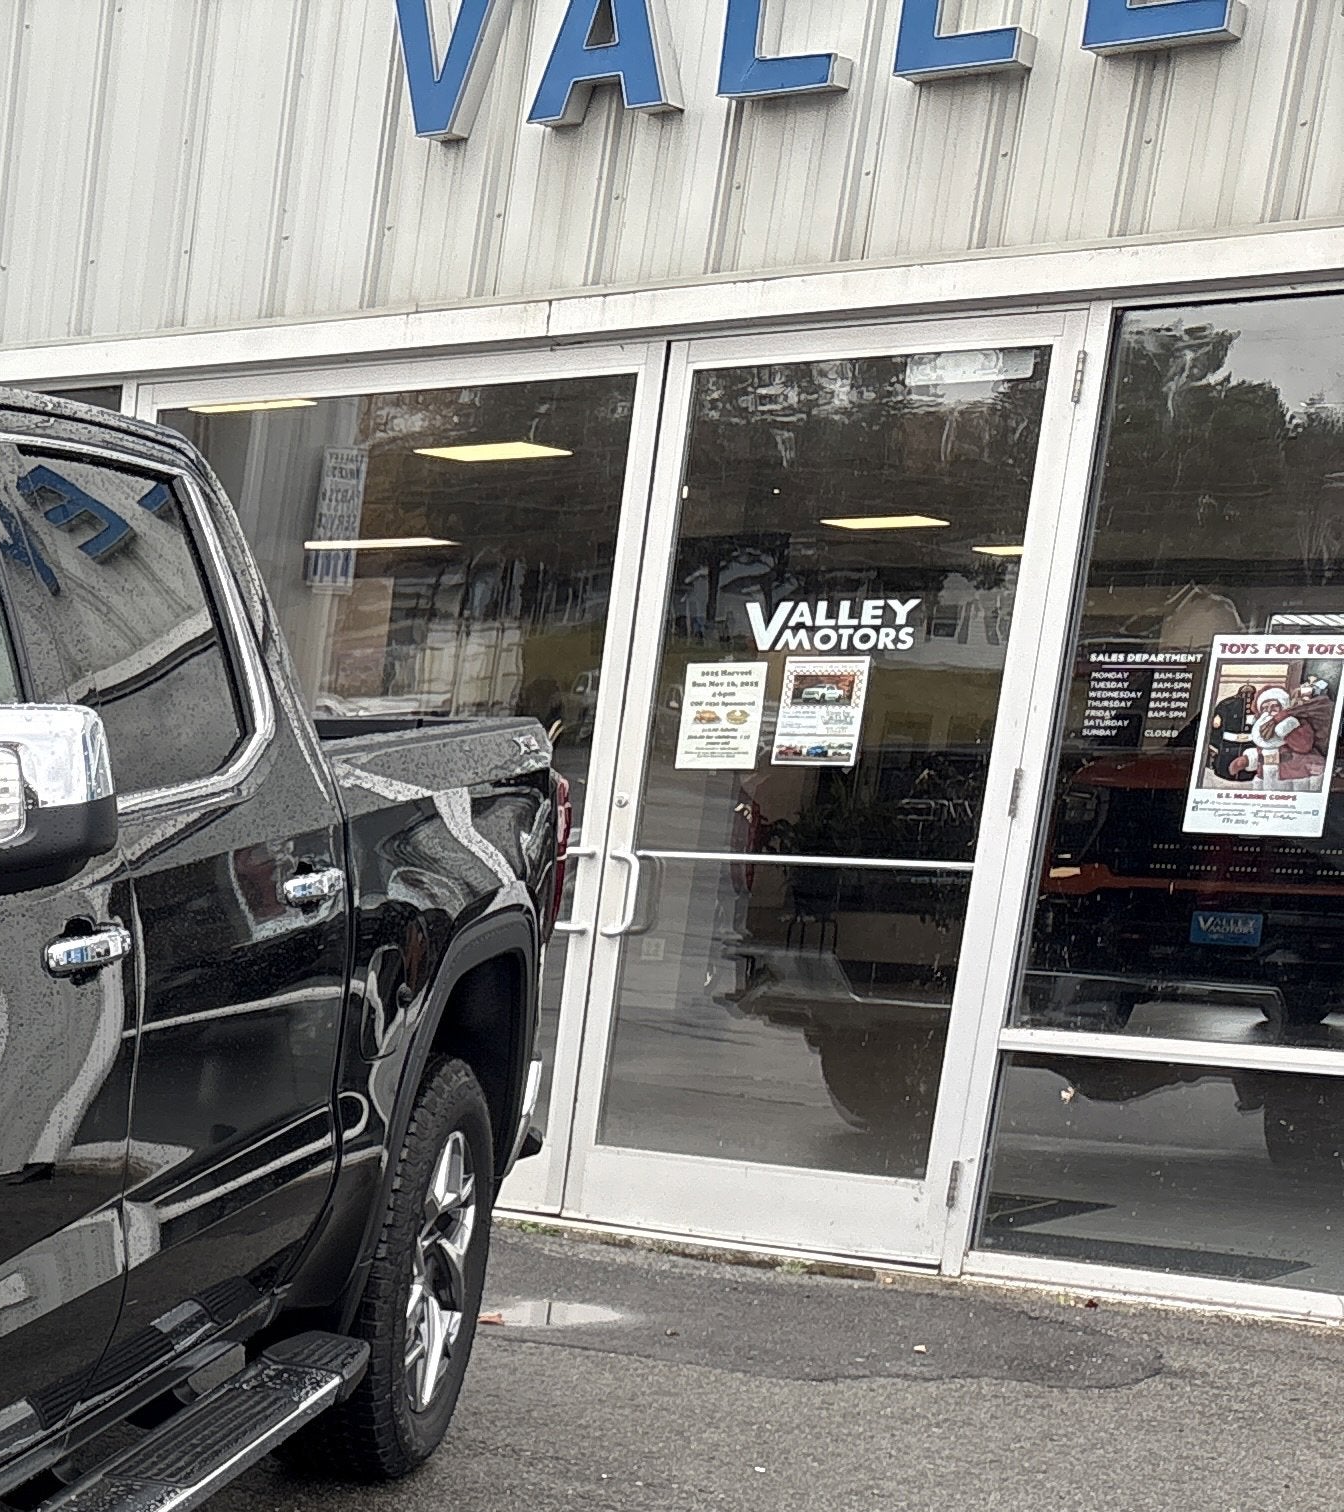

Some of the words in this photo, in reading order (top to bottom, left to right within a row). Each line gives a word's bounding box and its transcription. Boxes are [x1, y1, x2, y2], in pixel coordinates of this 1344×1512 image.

[396, 0, 1244, 142] VALL
[745, 598, 922, 651] VALLEY
[774, 627, 915, 651] MOTORS
[1219, 643, 1260, 655] TOYS
[1264, 643, 1302, 655] FOR
[1307, 643, 1344, 656] TOTS
[1089, 653, 1125, 662] SALES
[1126, 653, 1204, 663] DEPARTMENT
[1090, 681, 1130, 689] TUESDAY
[1088, 690, 1143, 698] WEDNESDAY
[1087, 699, 1133, 708] THURSDAY
[1085, 709, 1117, 717] FRIDAY
[1083, 719, 1130, 727] SATURDAY
[1081, 728, 1118, 736] SUNDAY
[1144, 729, 1180, 738] CLOSED
